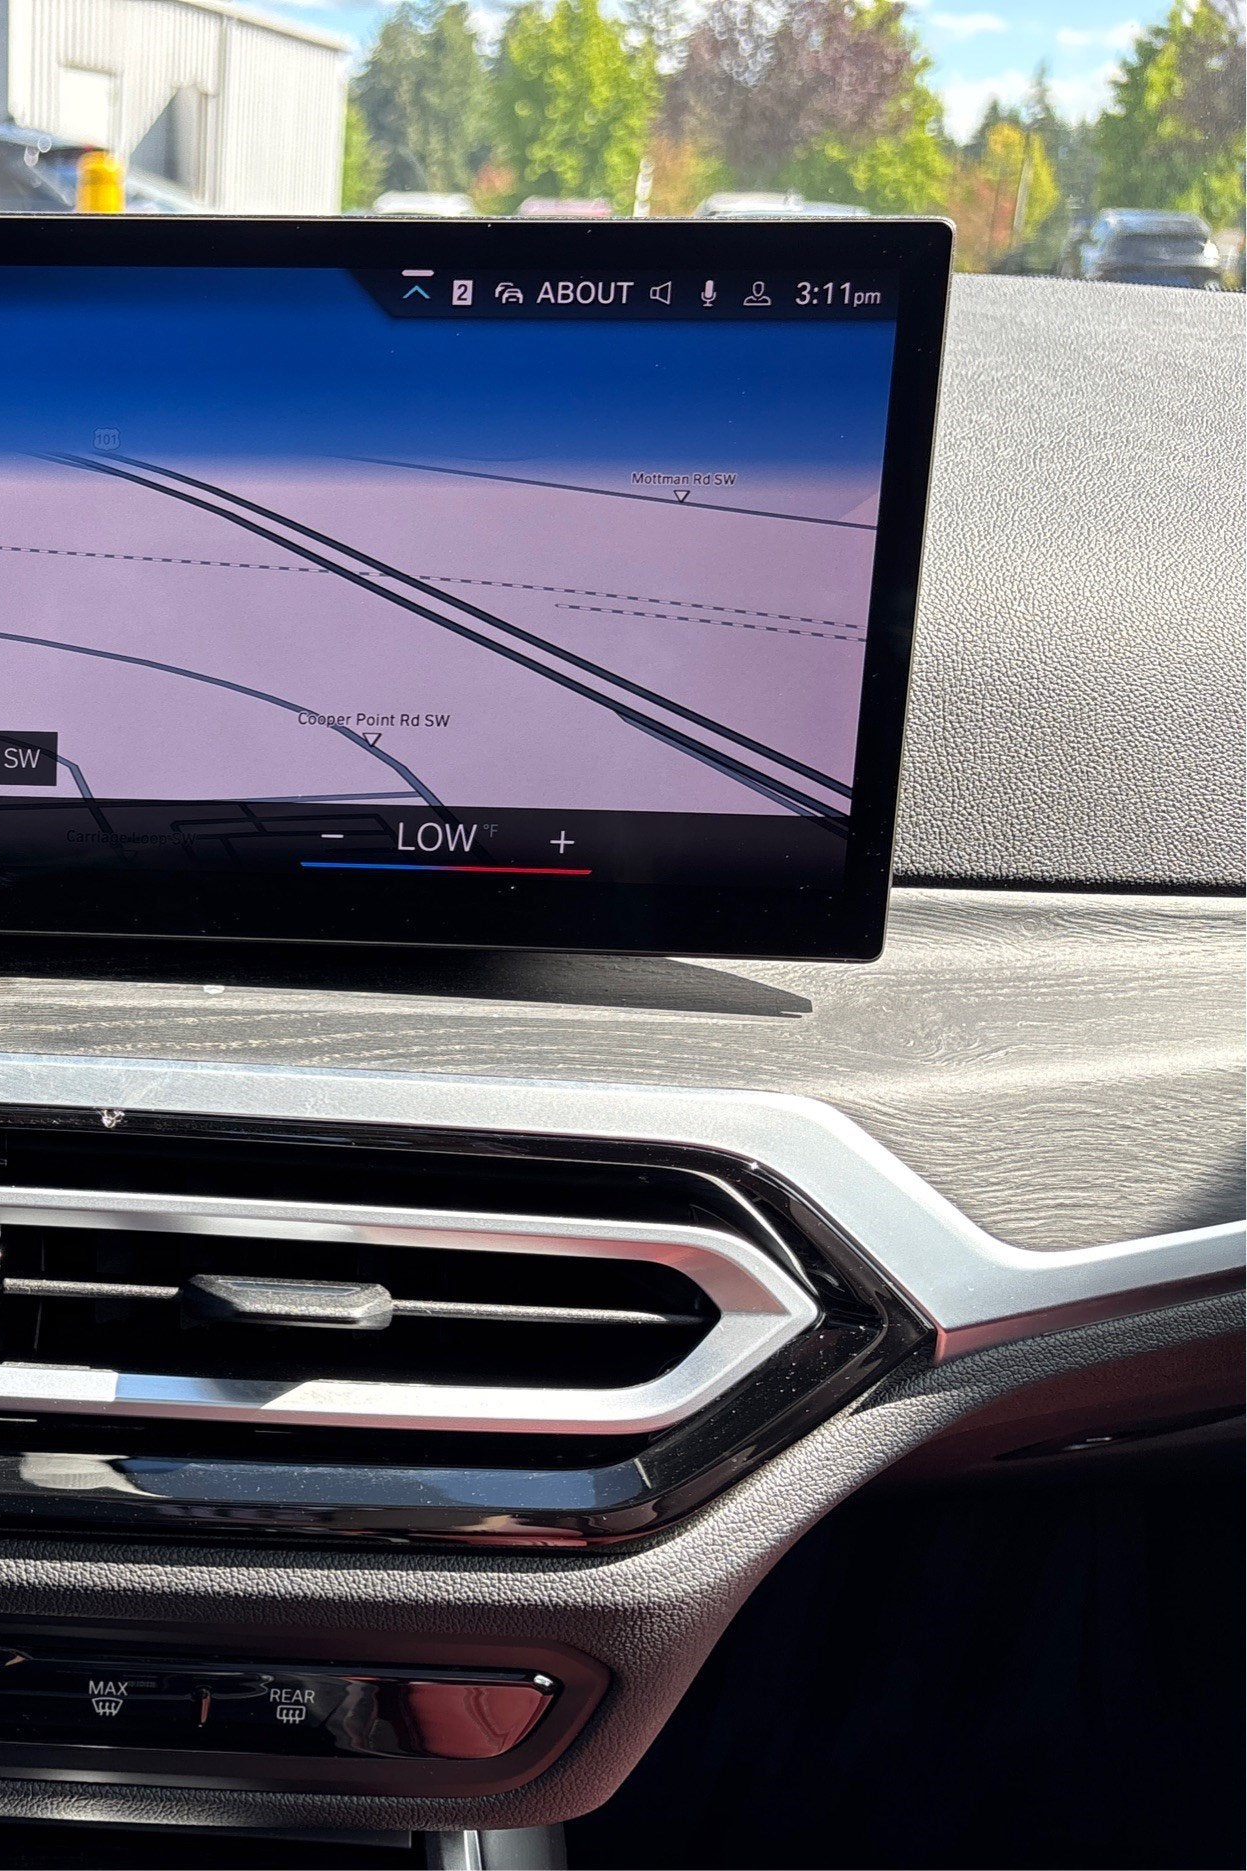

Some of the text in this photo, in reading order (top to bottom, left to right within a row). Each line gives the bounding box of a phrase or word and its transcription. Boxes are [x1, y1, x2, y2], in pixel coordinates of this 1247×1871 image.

[536, 281, 635, 304] ABOUT
[96, 433, 117, 446] 101
[632, 472, 737, 486] Mottman Rd SW
[297, 711, 451, 728] Cooper Point Rd SW
[4, 747, 41, 769] SW
[66, 829, 128, 846] Carriage
[397, 821, 478, 853] LOW
[88, 1680, 128, 1696] MAX
[269, 1688, 315, 1704] REAR
